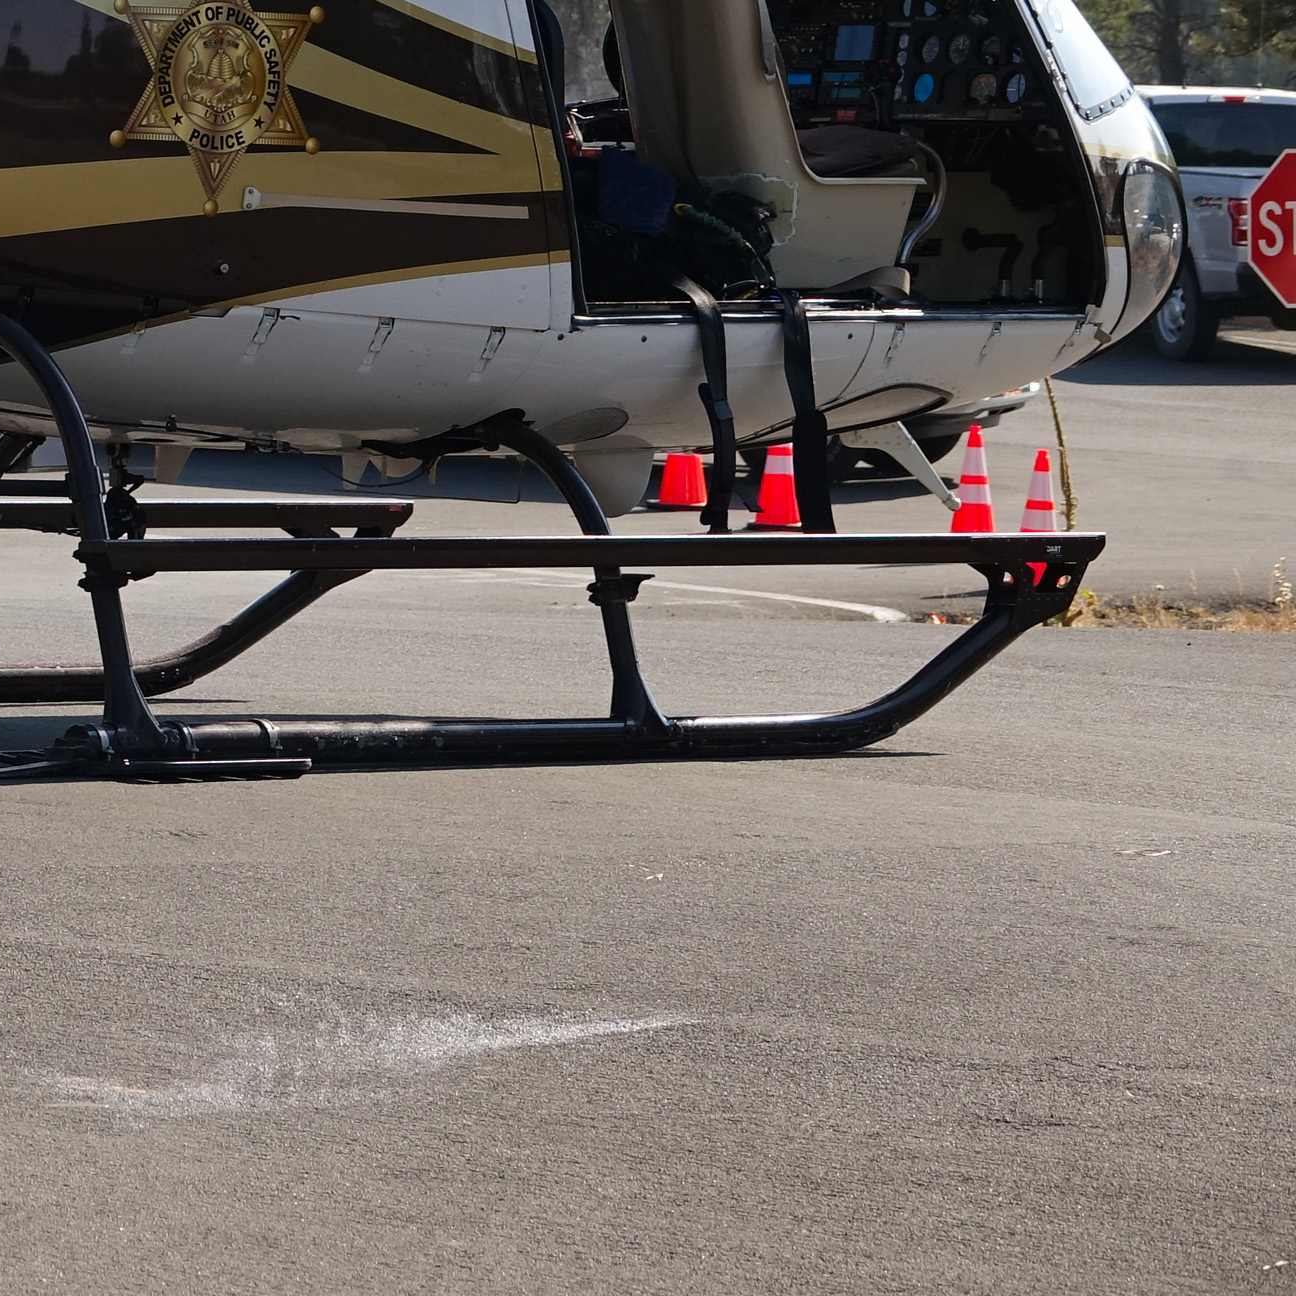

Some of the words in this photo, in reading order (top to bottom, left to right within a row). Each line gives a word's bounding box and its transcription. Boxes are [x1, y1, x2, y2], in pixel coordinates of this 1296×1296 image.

[158, 9, 202, 109] DEPARTMENT
[205, 6, 224, 21] OF
[226, 7, 271, 49] PUBLIC
[264, 48, 281, 114] SAFETY
[204, 110, 236, 124] UTAH
[188, 128, 246, 150] POLICE
